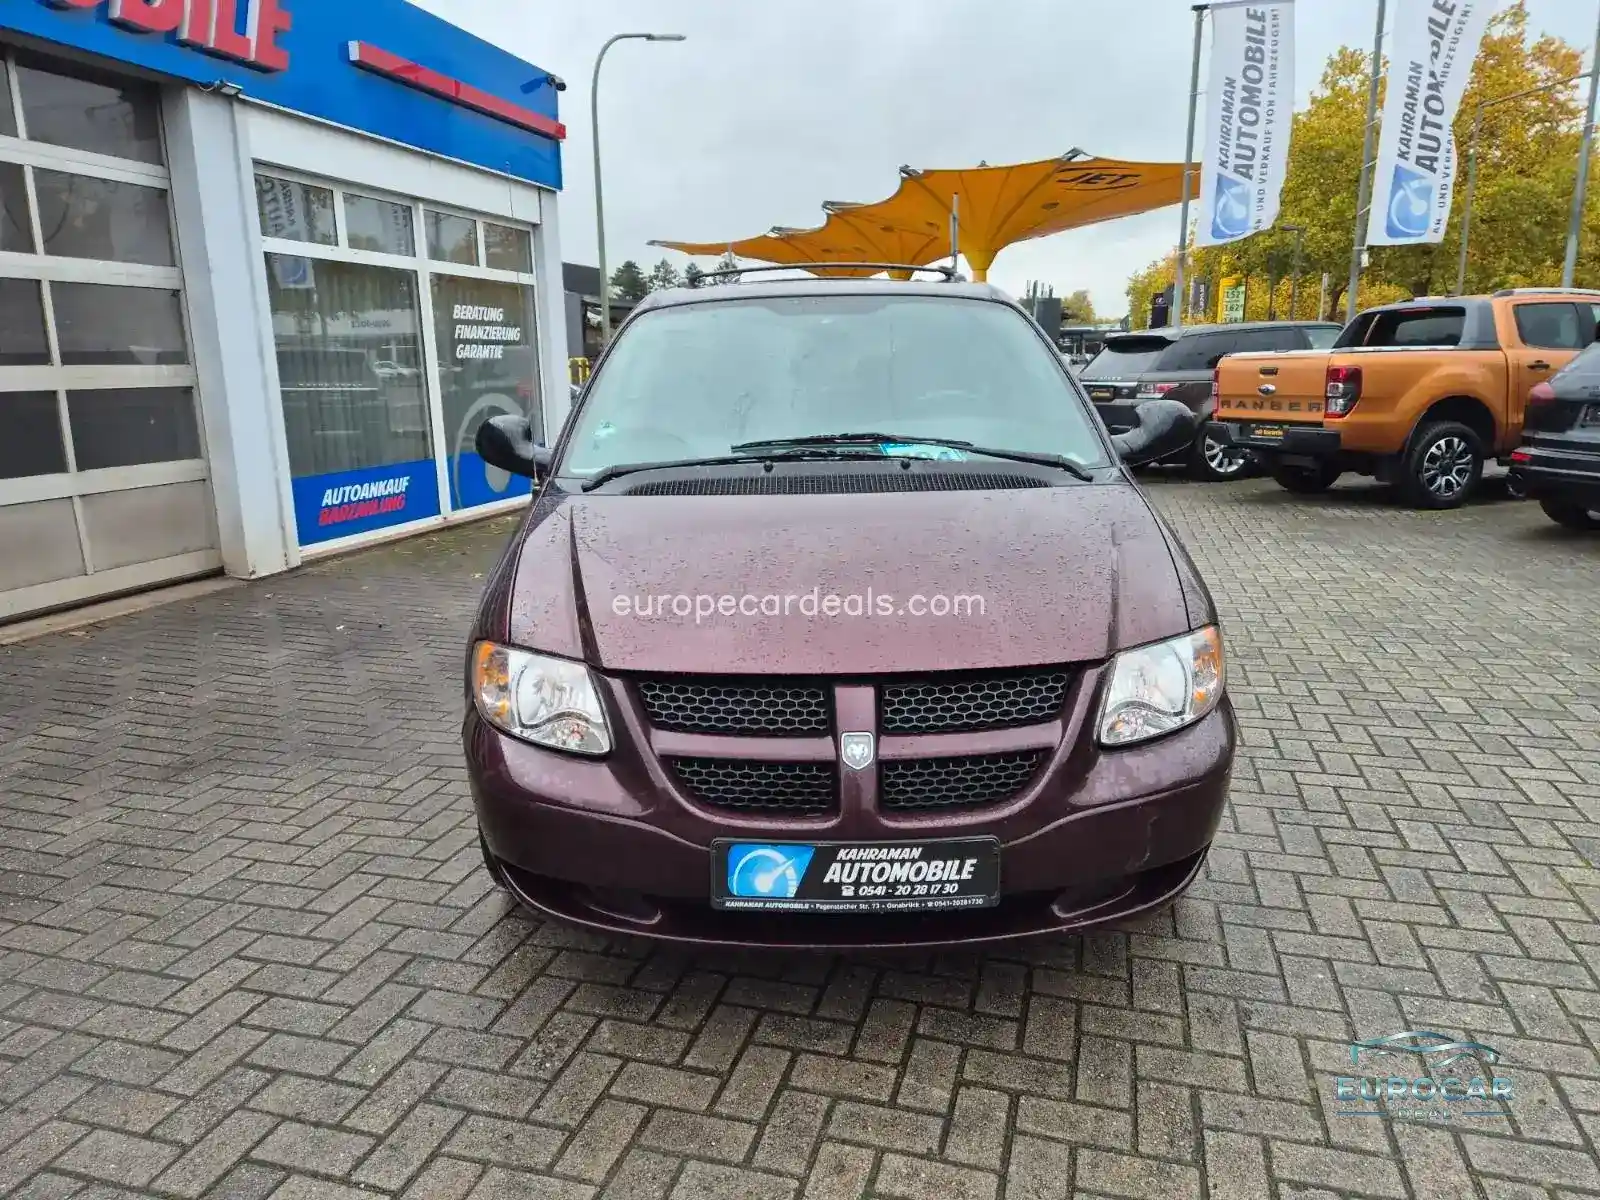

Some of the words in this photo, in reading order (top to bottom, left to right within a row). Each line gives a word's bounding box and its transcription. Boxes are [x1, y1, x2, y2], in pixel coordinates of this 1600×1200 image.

[1231, 8, 1267, 181] AUTOMOBILE
[1266, 101, 1277, 126] VON
[1397, 60, 1424, 161] KAHRAMAN
[1218, 76, 1237, 170] KAHRAMAN
[1258, 129, 1273, 184] VERKAUF
[1256, 188, 1266, 212] UND
[1437, 184, 1449, 209] UND
[452, 304, 504, 322] BERATUNG
[454, 324, 521, 341] FINANZIERUNG
[455, 343, 503, 359] GARANTIE
[1221, 400, 1323, 412] RANGER
[321, 476, 411, 507] AUTOANKAUF
[836, 847, 923, 861] KAHRAMAN
[822, 858, 978, 884] AUTOMOBILE
[858, 885, 886, 897] 0541
[894, 884, 911, 896] 20
[912, 884, 928, 896] 28
[929, 883, 941, 895] 17
[943, 883, 959, 895] 30
[725, 900, 764, 909] KAHRAMAN
[765, 901, 809, 910] AUTOMOBILE
[886, 901, 920, 909] Osnabrück
